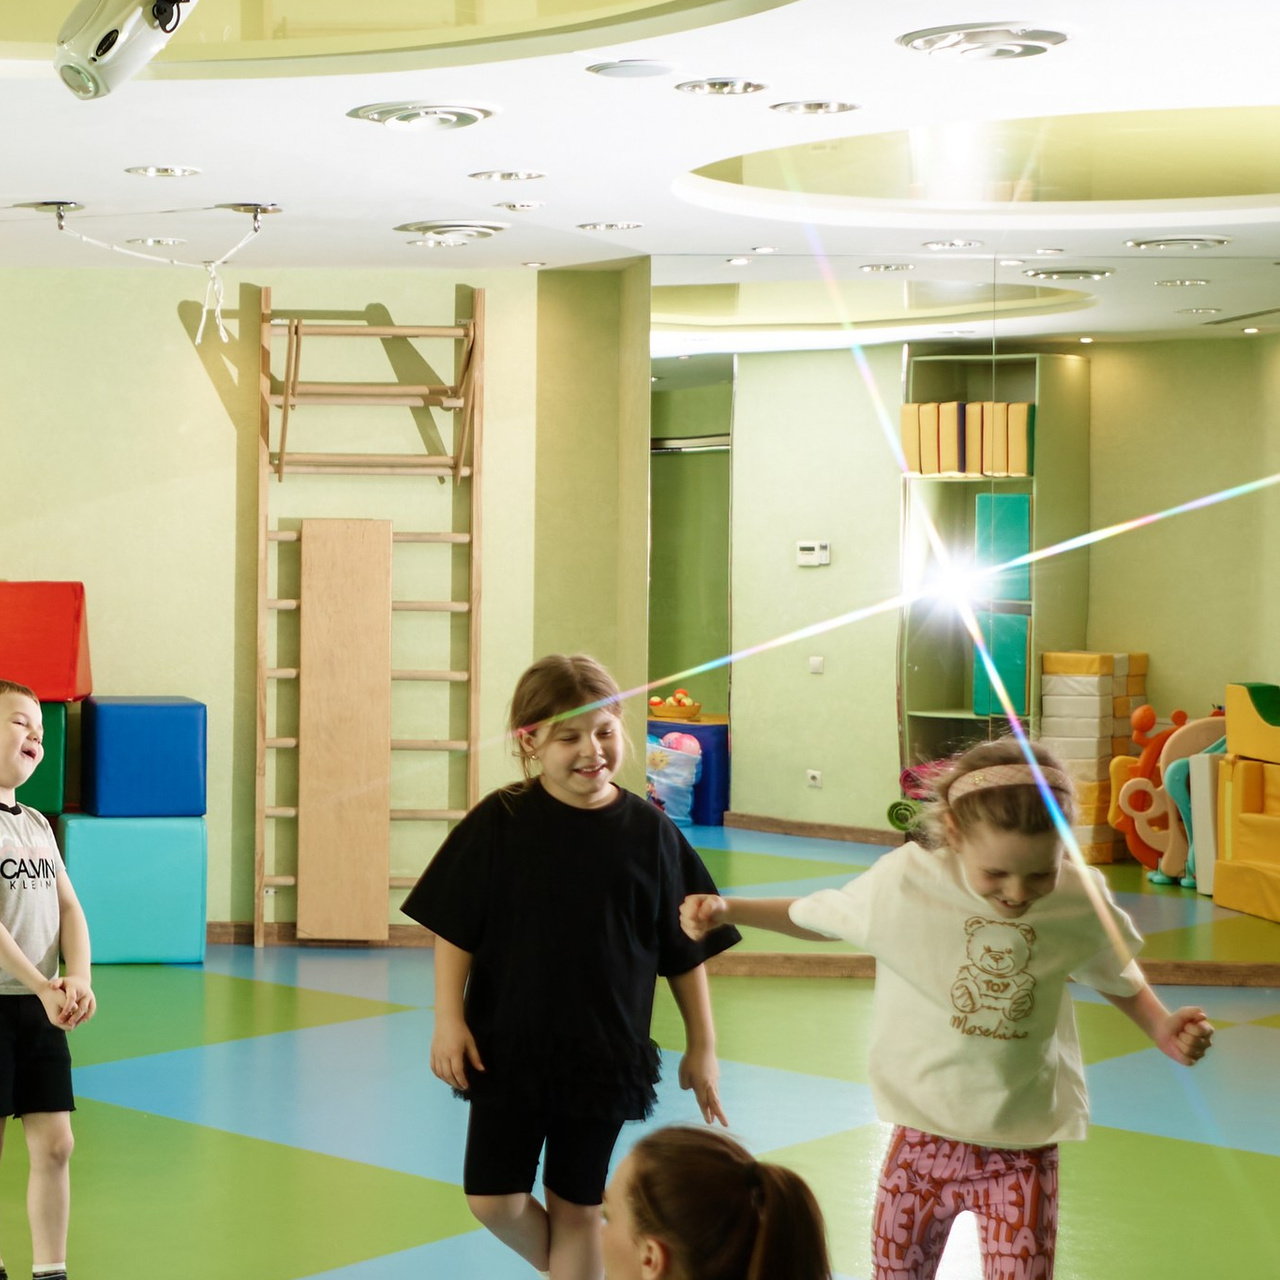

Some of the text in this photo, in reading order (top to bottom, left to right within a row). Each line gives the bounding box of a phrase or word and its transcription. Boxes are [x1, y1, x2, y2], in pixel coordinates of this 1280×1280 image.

[0, 858, 56, 880] CALVIN
[9, 880, 52, 890] KLEIN
[983, 979, 1012, 994] TOY
